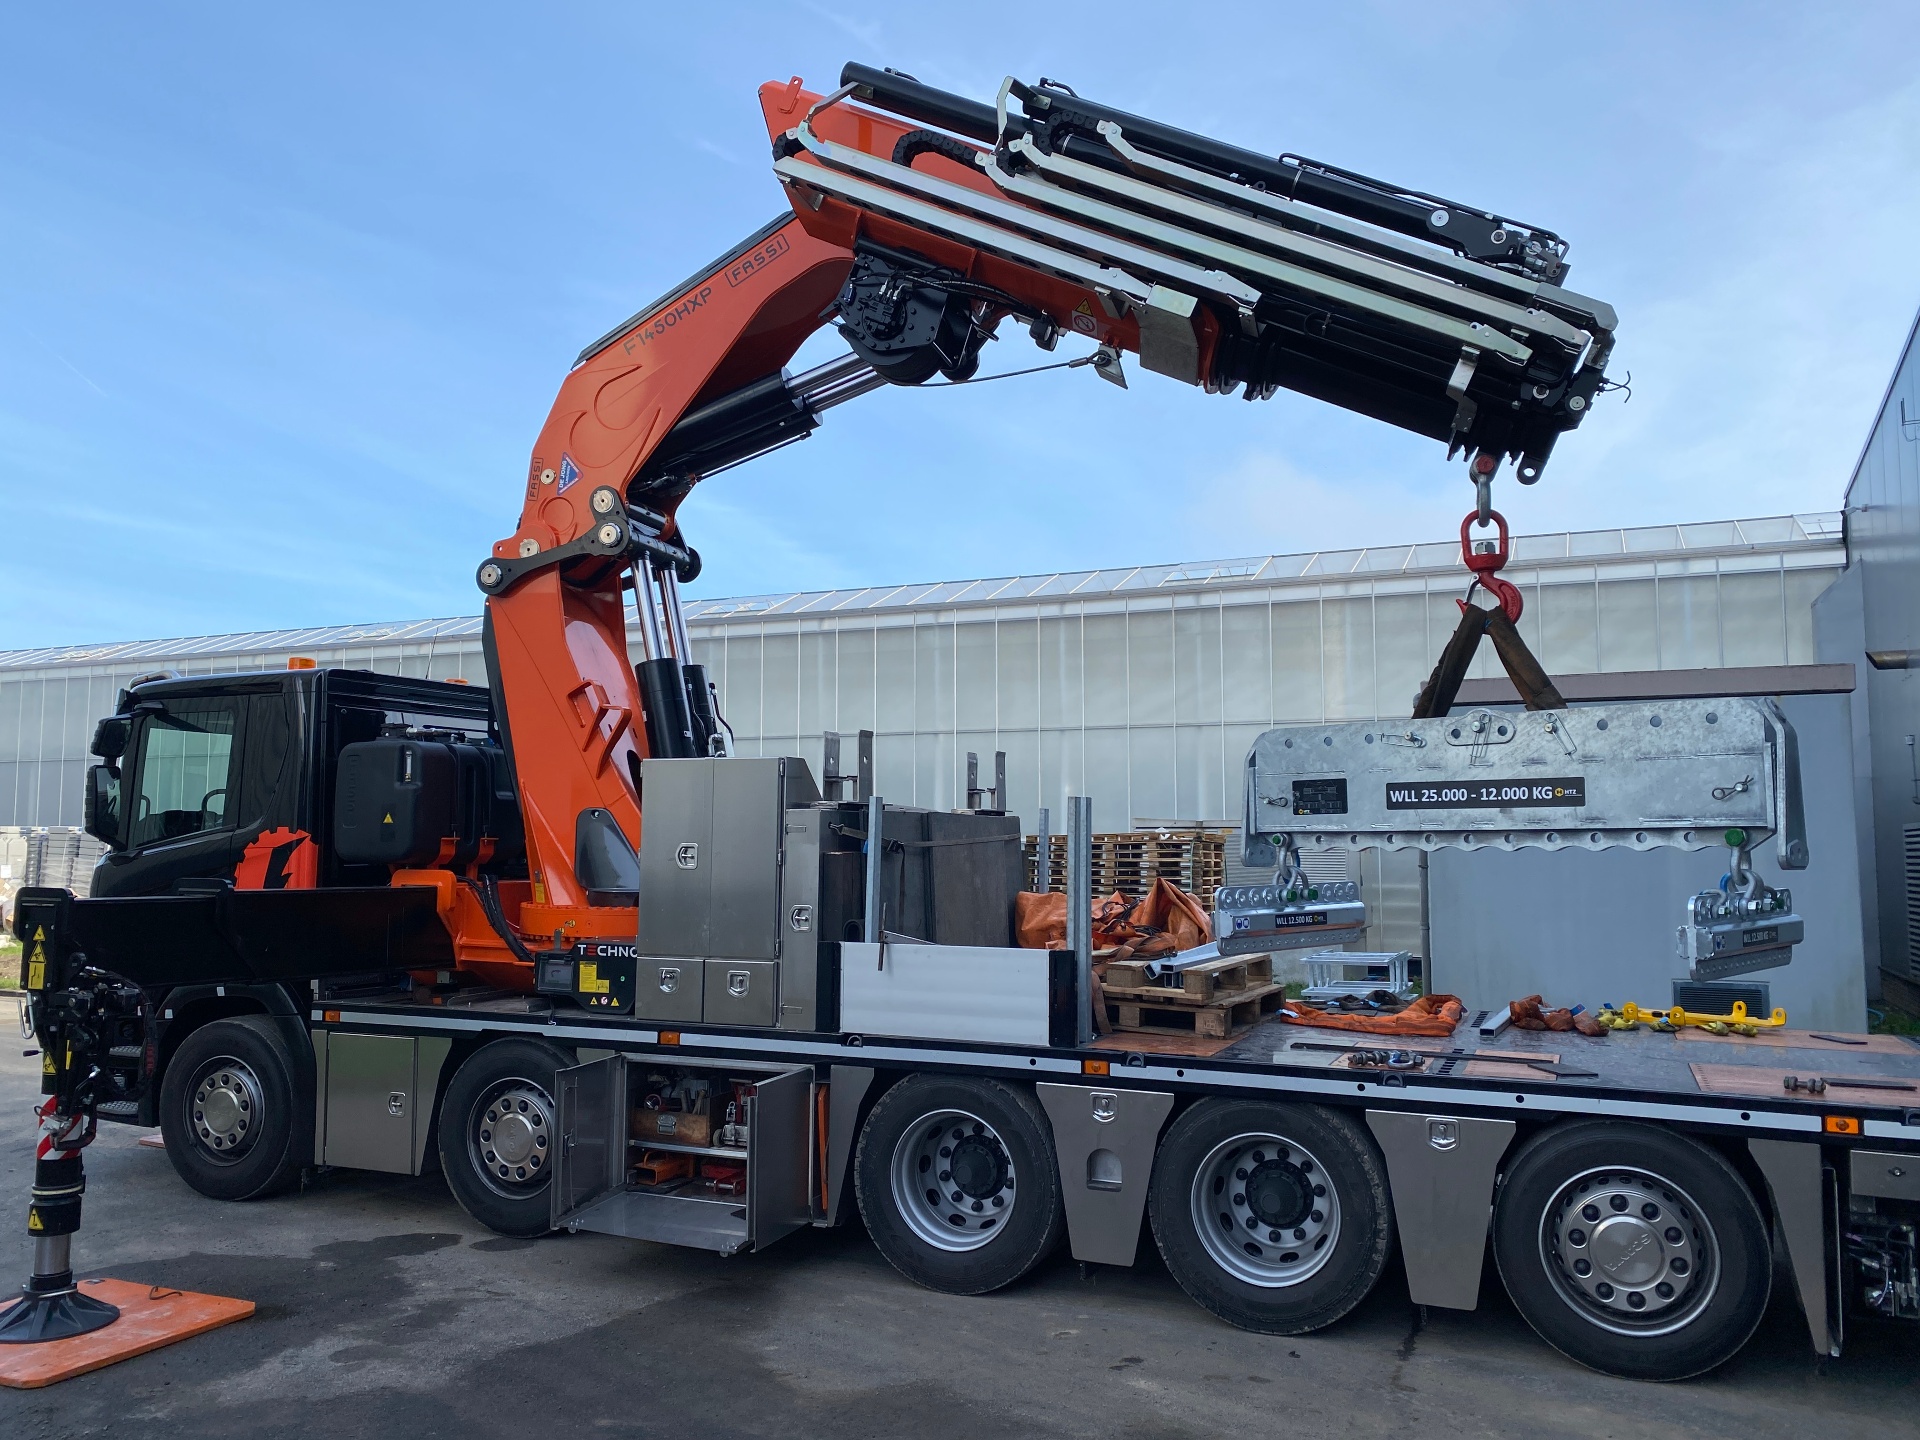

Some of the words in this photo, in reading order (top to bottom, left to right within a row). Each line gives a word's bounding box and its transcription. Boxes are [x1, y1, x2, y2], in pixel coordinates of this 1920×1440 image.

[731, 240, 783, 281] FASSI
[623, 287, 712, 356] F1450HXP
[530, 461, 541, 497] FASSI
[1390, 790, 1418, 802] WLL
[1421, 788, 1468, 802] 25.000
[1480, 787, 1529, 801] 12.000
[1533, 786, 1553, 799] KG
[1288, 915, 1305, 925] 12.500
